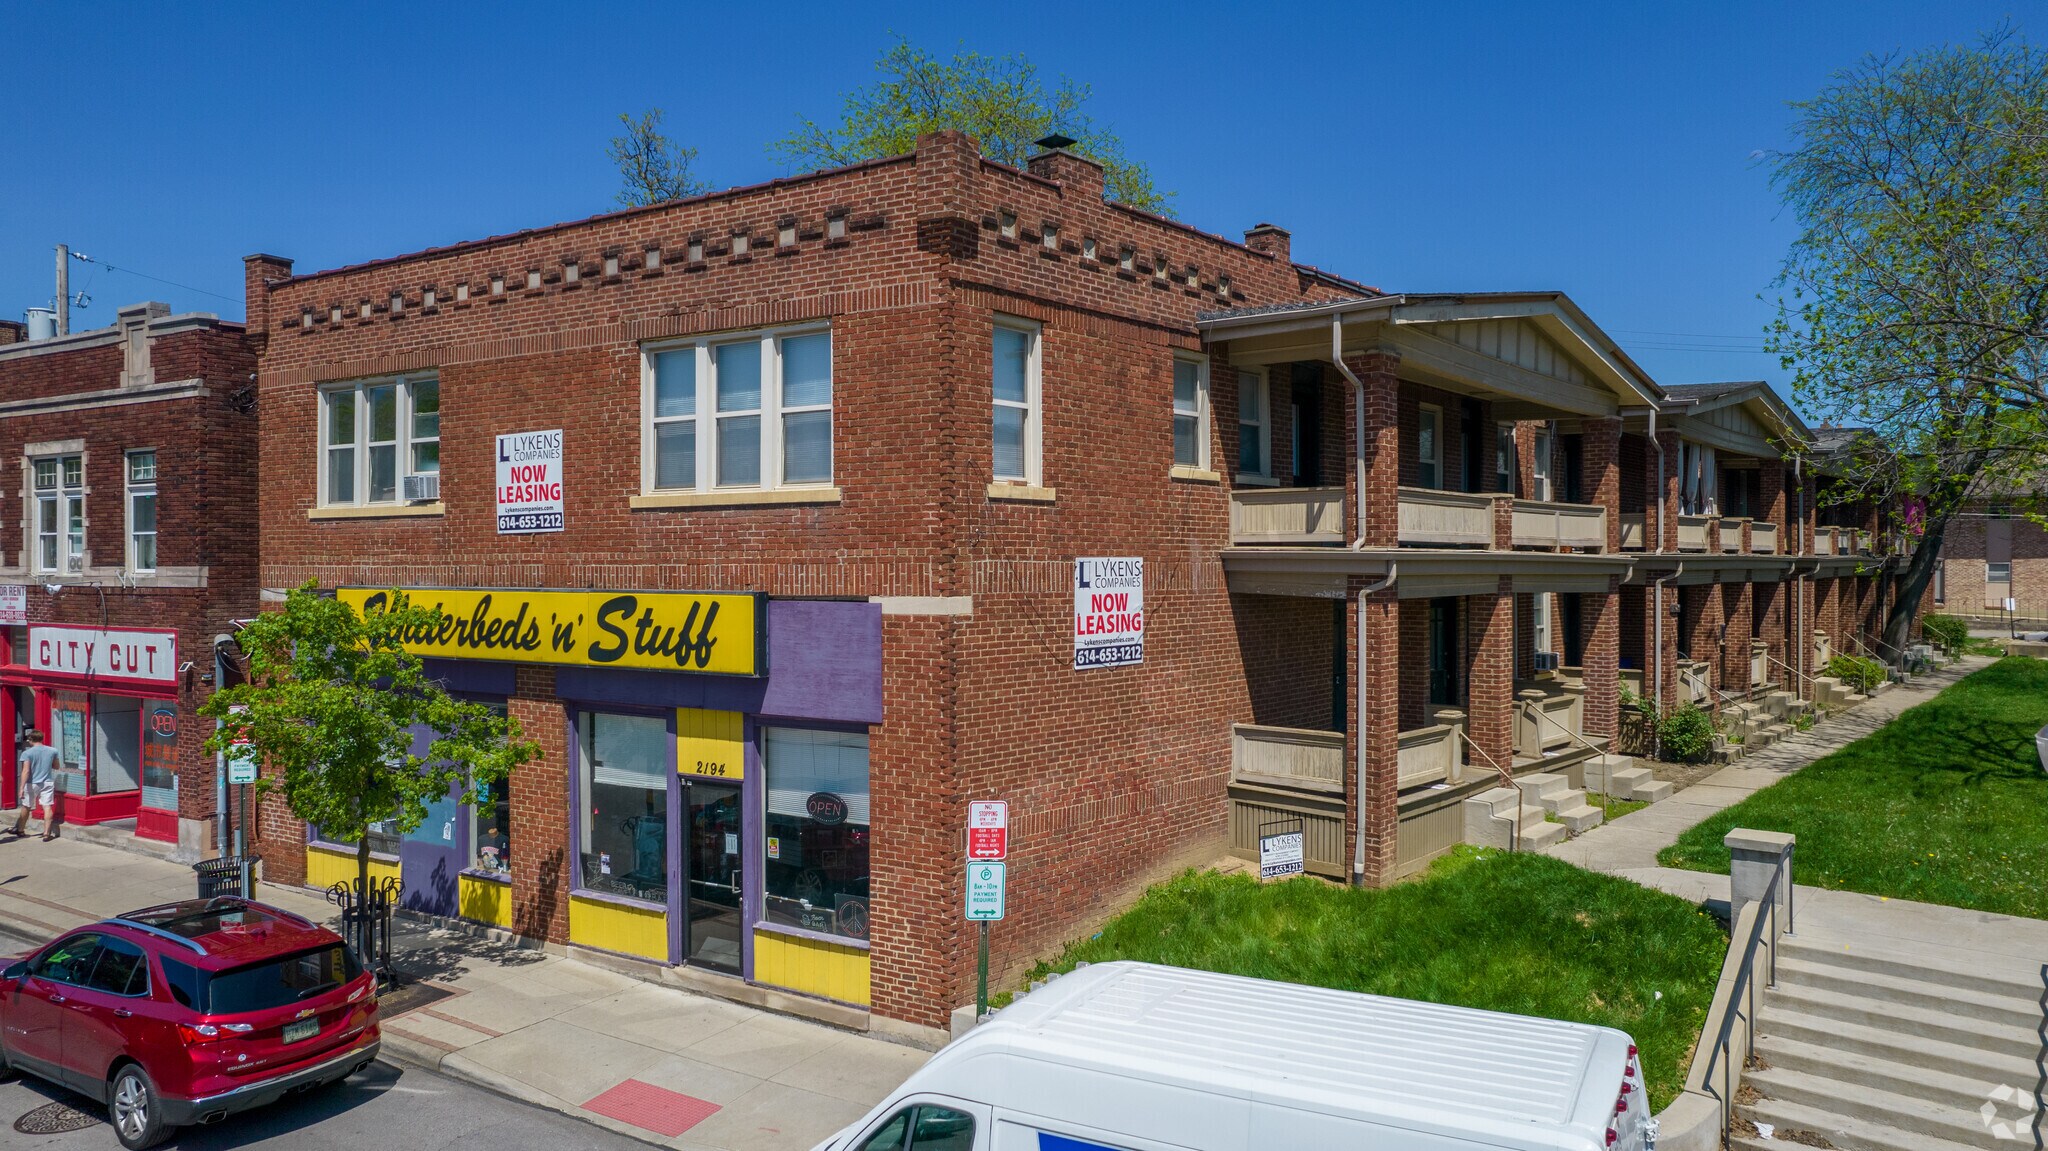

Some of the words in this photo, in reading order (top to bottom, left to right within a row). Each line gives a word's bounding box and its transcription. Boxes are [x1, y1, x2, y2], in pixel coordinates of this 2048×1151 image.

[514, 433, 560, 451] LYKENS
[514, 449, 560, 461] COMPANIES
[511, 464, 546, 484] NOW
[498, 483, 560, 503] LEASING
[500, 514, 561, 529] 614-653-1212
[1095, 560, 1140, 577] LYKENS
[1095, 577, 1140, 588] COMPANIES
[9, 586, 24, 596] RENT
[1092, 593, 1128, 613] NOW
[588, 595, 720, 668] Stuff
[1077, 612, 1141, 635] LEASING
[40, 640, 94, 668] CITY
[110, 643, 157, 674] CUT
[1077, 646, 1141, 664] 614-653-1212
[151, 715, 176, 731] OPEN
[696, 761, 725, 776] 2194
[809, 801, 841, 816] OPEN
[1272, 834, 1301, 847] LYKENS
[1272, 843, 1301, 852] COMPANIES
[1263, 862, 1302, 876] 614-653-1212
